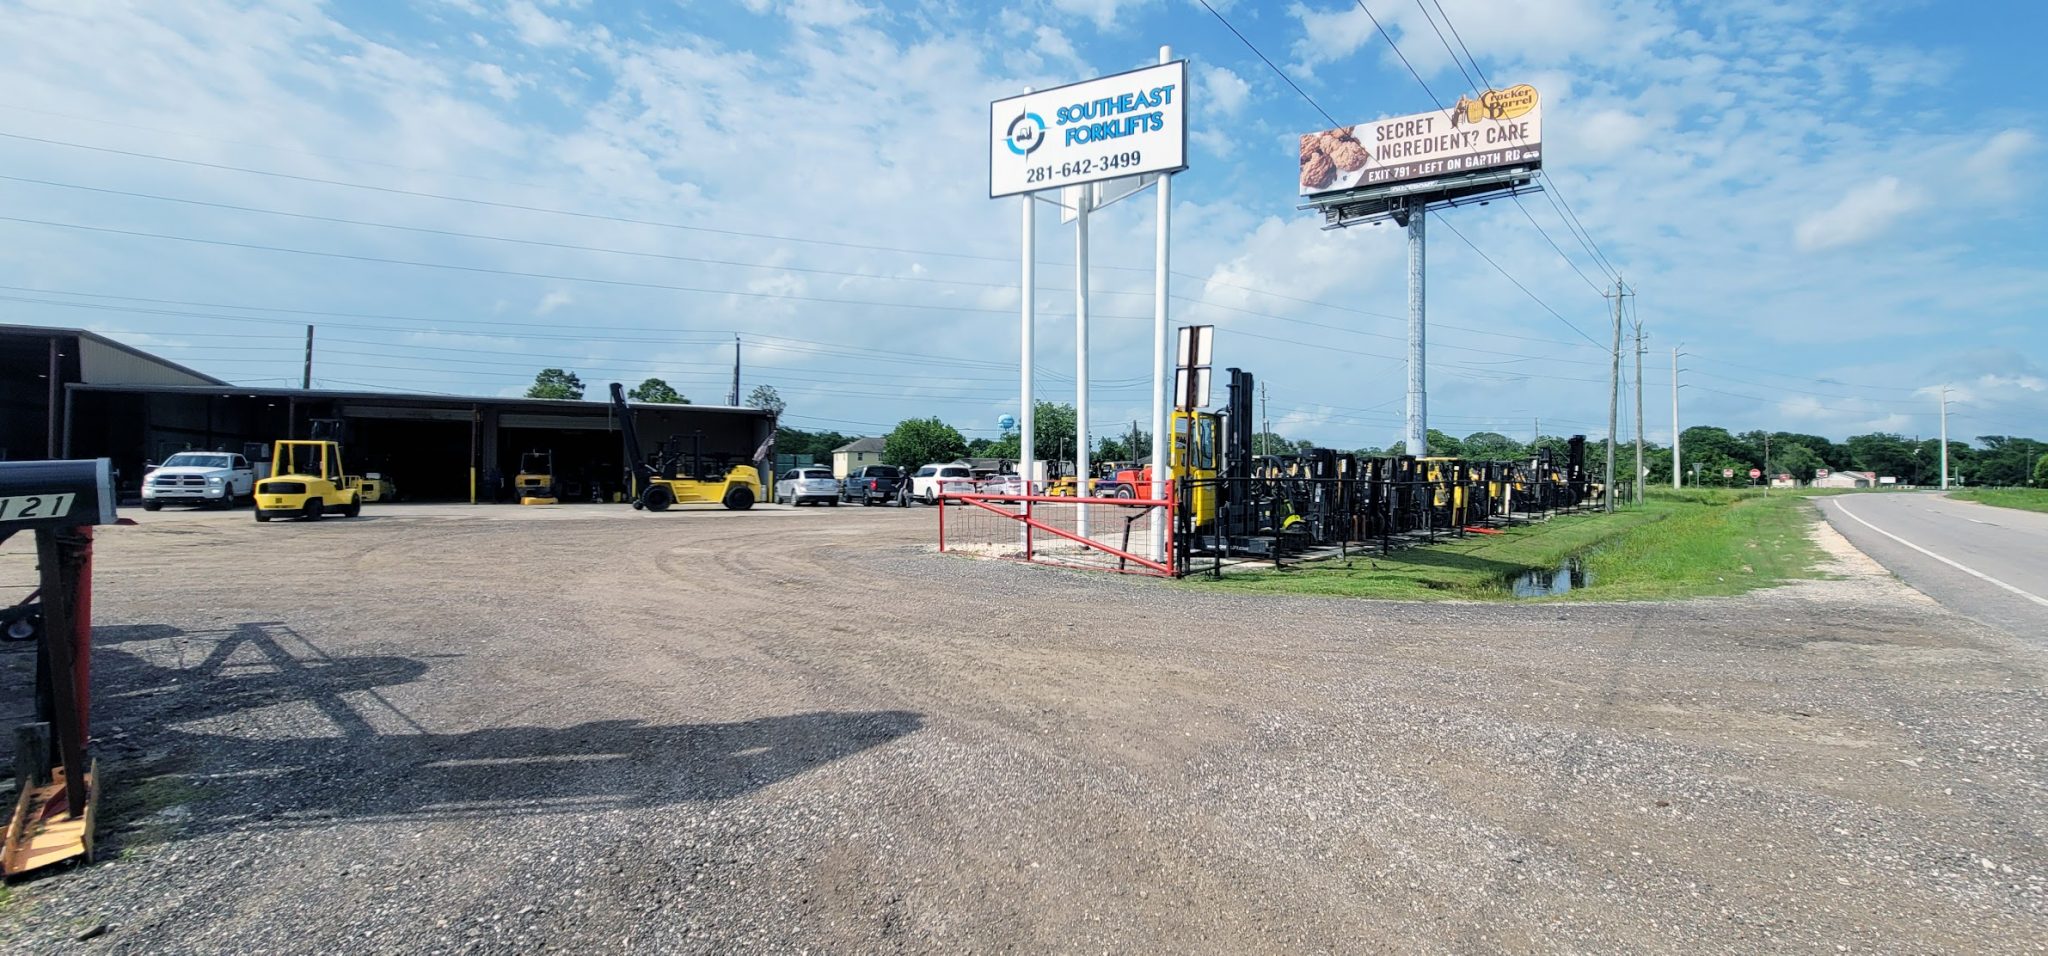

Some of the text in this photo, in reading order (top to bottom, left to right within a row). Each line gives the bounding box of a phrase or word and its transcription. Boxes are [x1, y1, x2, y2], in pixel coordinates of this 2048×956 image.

[1056, 84, 1175, 125] SOUTHEAST
[1481, 90, 1532, 110] Cracker
[1489, 95, 1532, 120] Barrel
[1065, 111, 1164, 147] FORKLIFTS
[1376, 117, 1434, 142] SECRET
[1376, 122, 1529, 161] INGREDIENT? CARE
[1027, 151, 1141, 183] 281-642-3499
[1368, 169, 1390, 182] EXIT
[1394, 166, 1410, 179] 791
[1418, 161, 1443, 175] LEFT
[1447, 158, 1462, 171] ON
[1465, 152, 1501, 168] GARTH
